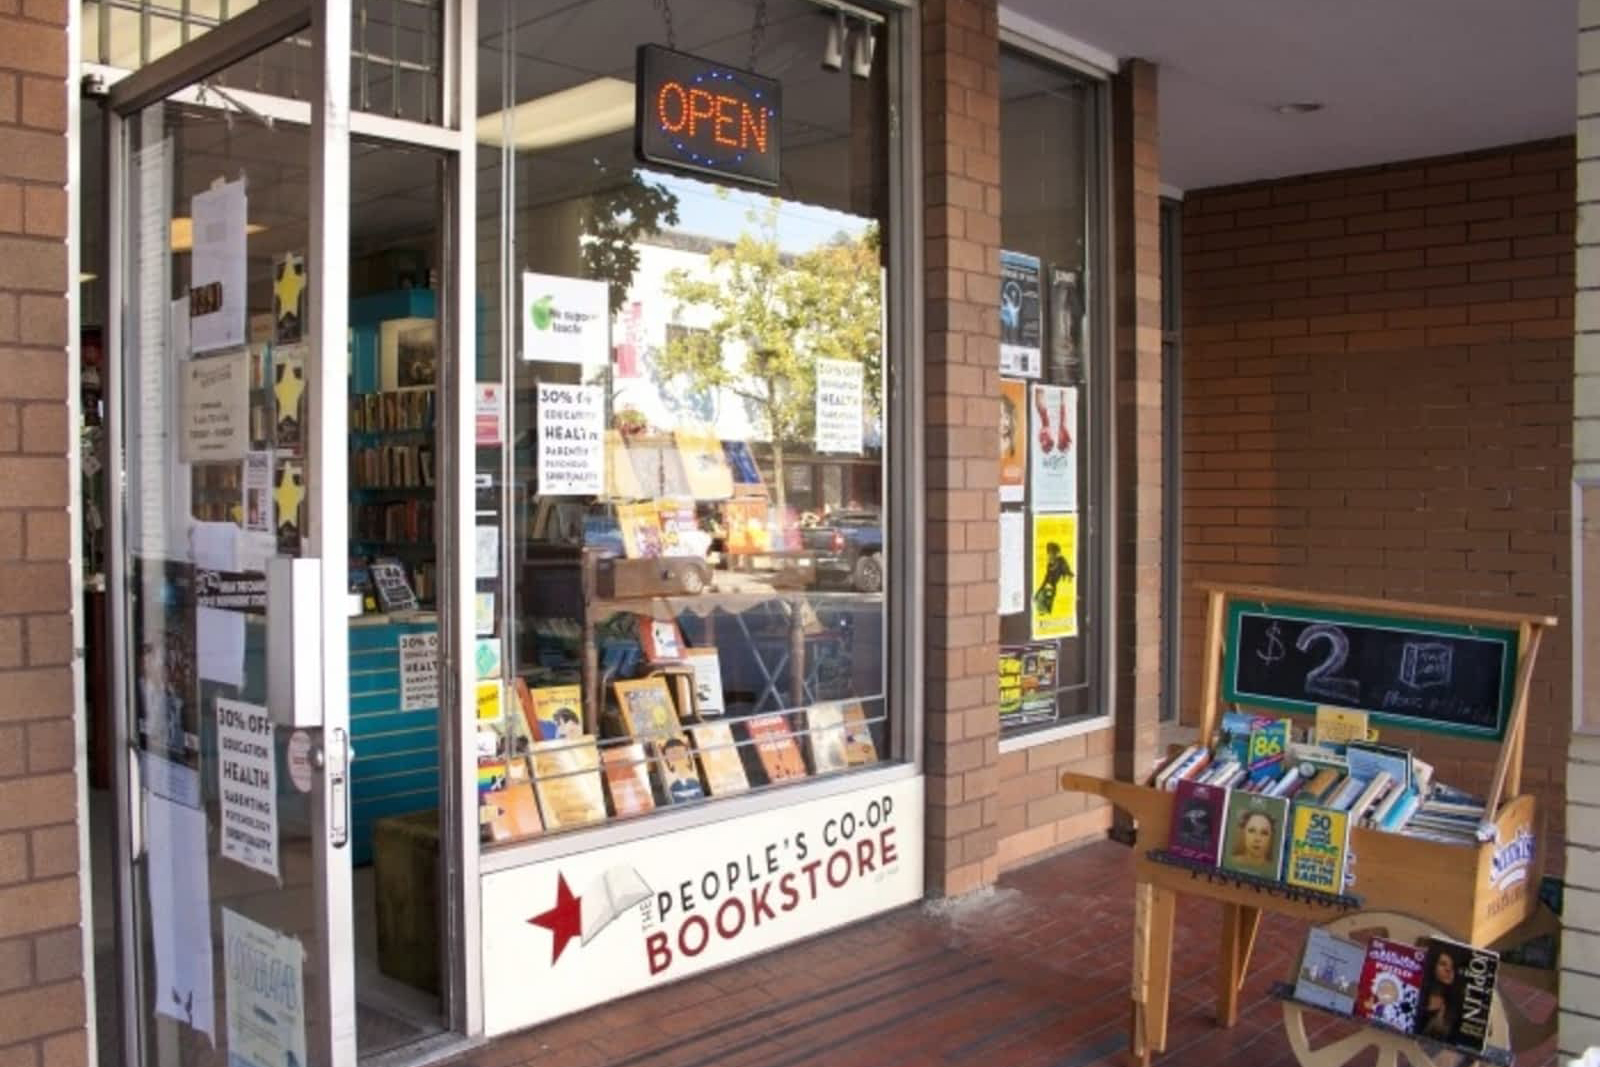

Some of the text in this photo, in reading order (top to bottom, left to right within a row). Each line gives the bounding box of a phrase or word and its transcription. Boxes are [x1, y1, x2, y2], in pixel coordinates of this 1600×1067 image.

[656, 81, 768, 154] OPEN
[541, 390, 573, 404] 30%
[219, 708, 272, 737] 30% OFF
[223, 737, 269, 759] EDUCATION
[1254, 737, 1281, 756] 86
[223, 761, 270, 790] HEALTH
[658, 795, 894, 923] PEOPLE'S CO-OP
[639, 897, 654, 931] THE
[646, 829, 898, 975] BOOKSTORE
